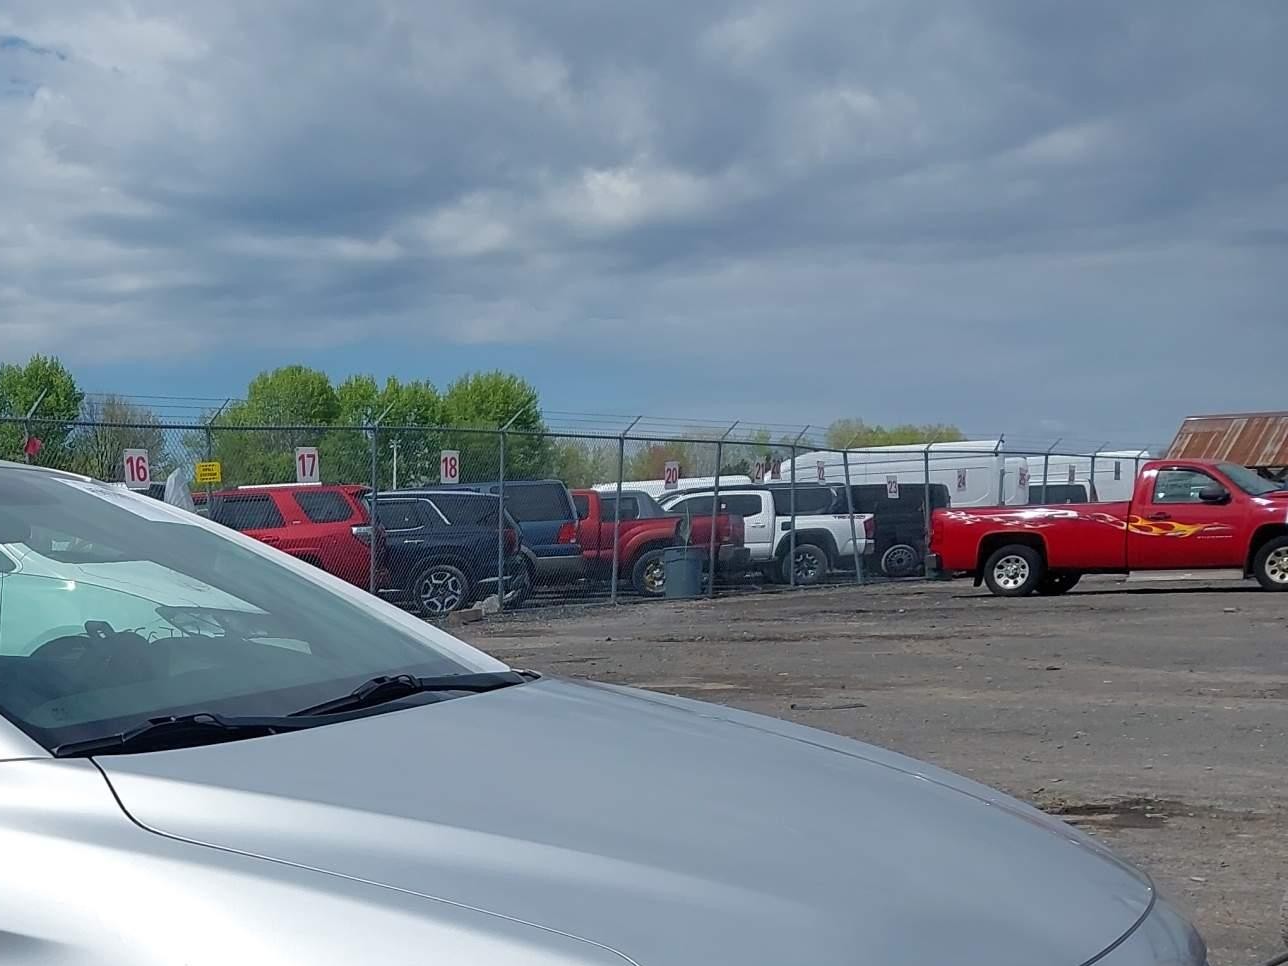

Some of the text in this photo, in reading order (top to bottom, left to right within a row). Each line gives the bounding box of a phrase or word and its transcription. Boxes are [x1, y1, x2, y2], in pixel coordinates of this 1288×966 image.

[126, 456, 148, 482] 16
[298, 454, 316, 477] 17
[443, 457, 457, 479] 18
[666, 467, 678, 484] 20
